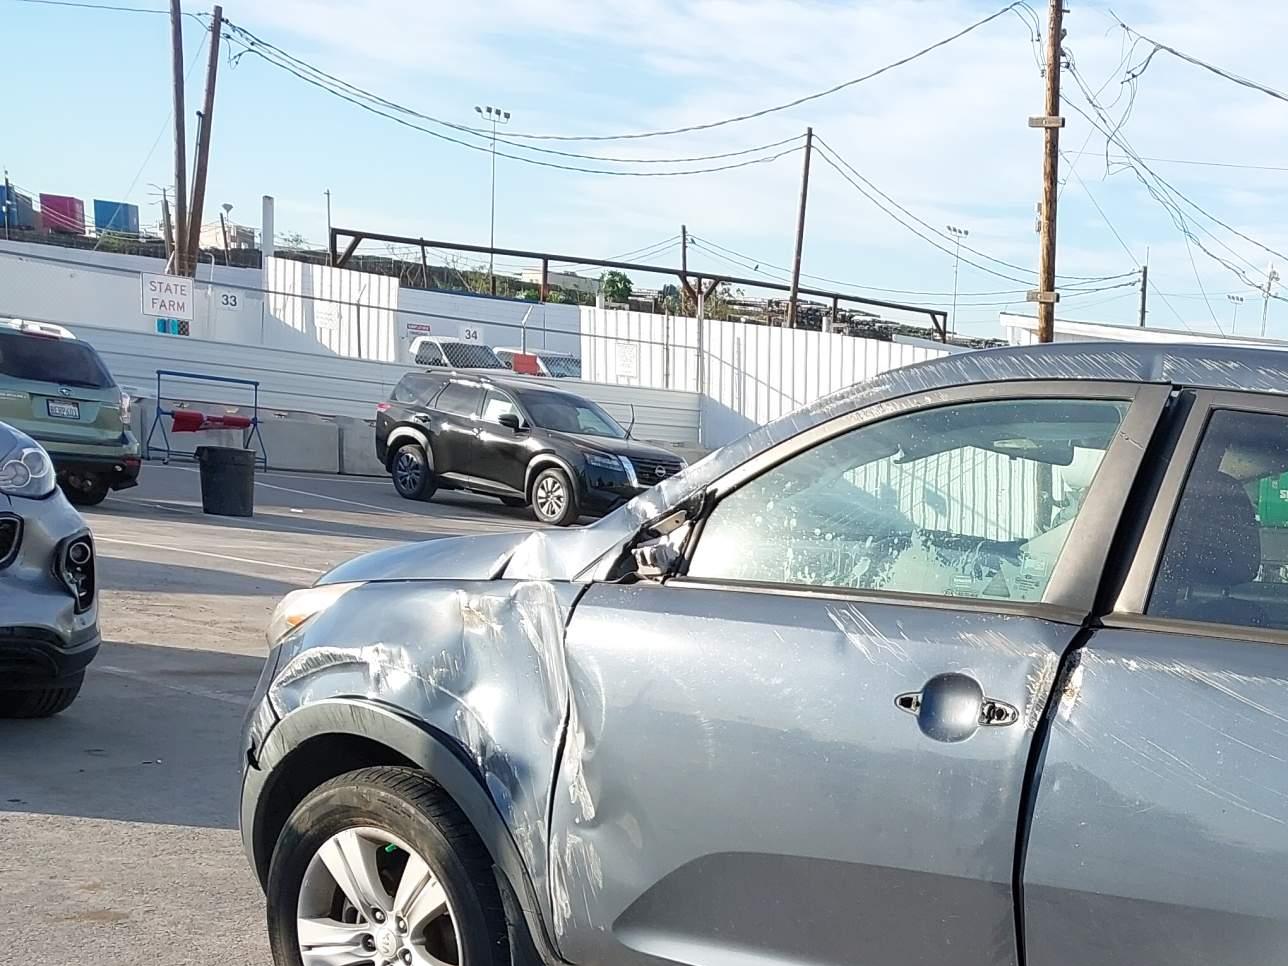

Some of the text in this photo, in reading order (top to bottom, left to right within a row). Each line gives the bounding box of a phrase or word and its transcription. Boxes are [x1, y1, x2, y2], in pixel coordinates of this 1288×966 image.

[149, 280, 187, 296] STATE
[151, 298, 185, 312] FARM
[221, 294, 238, 307] 33
[465, 329, 478, 340] 34
